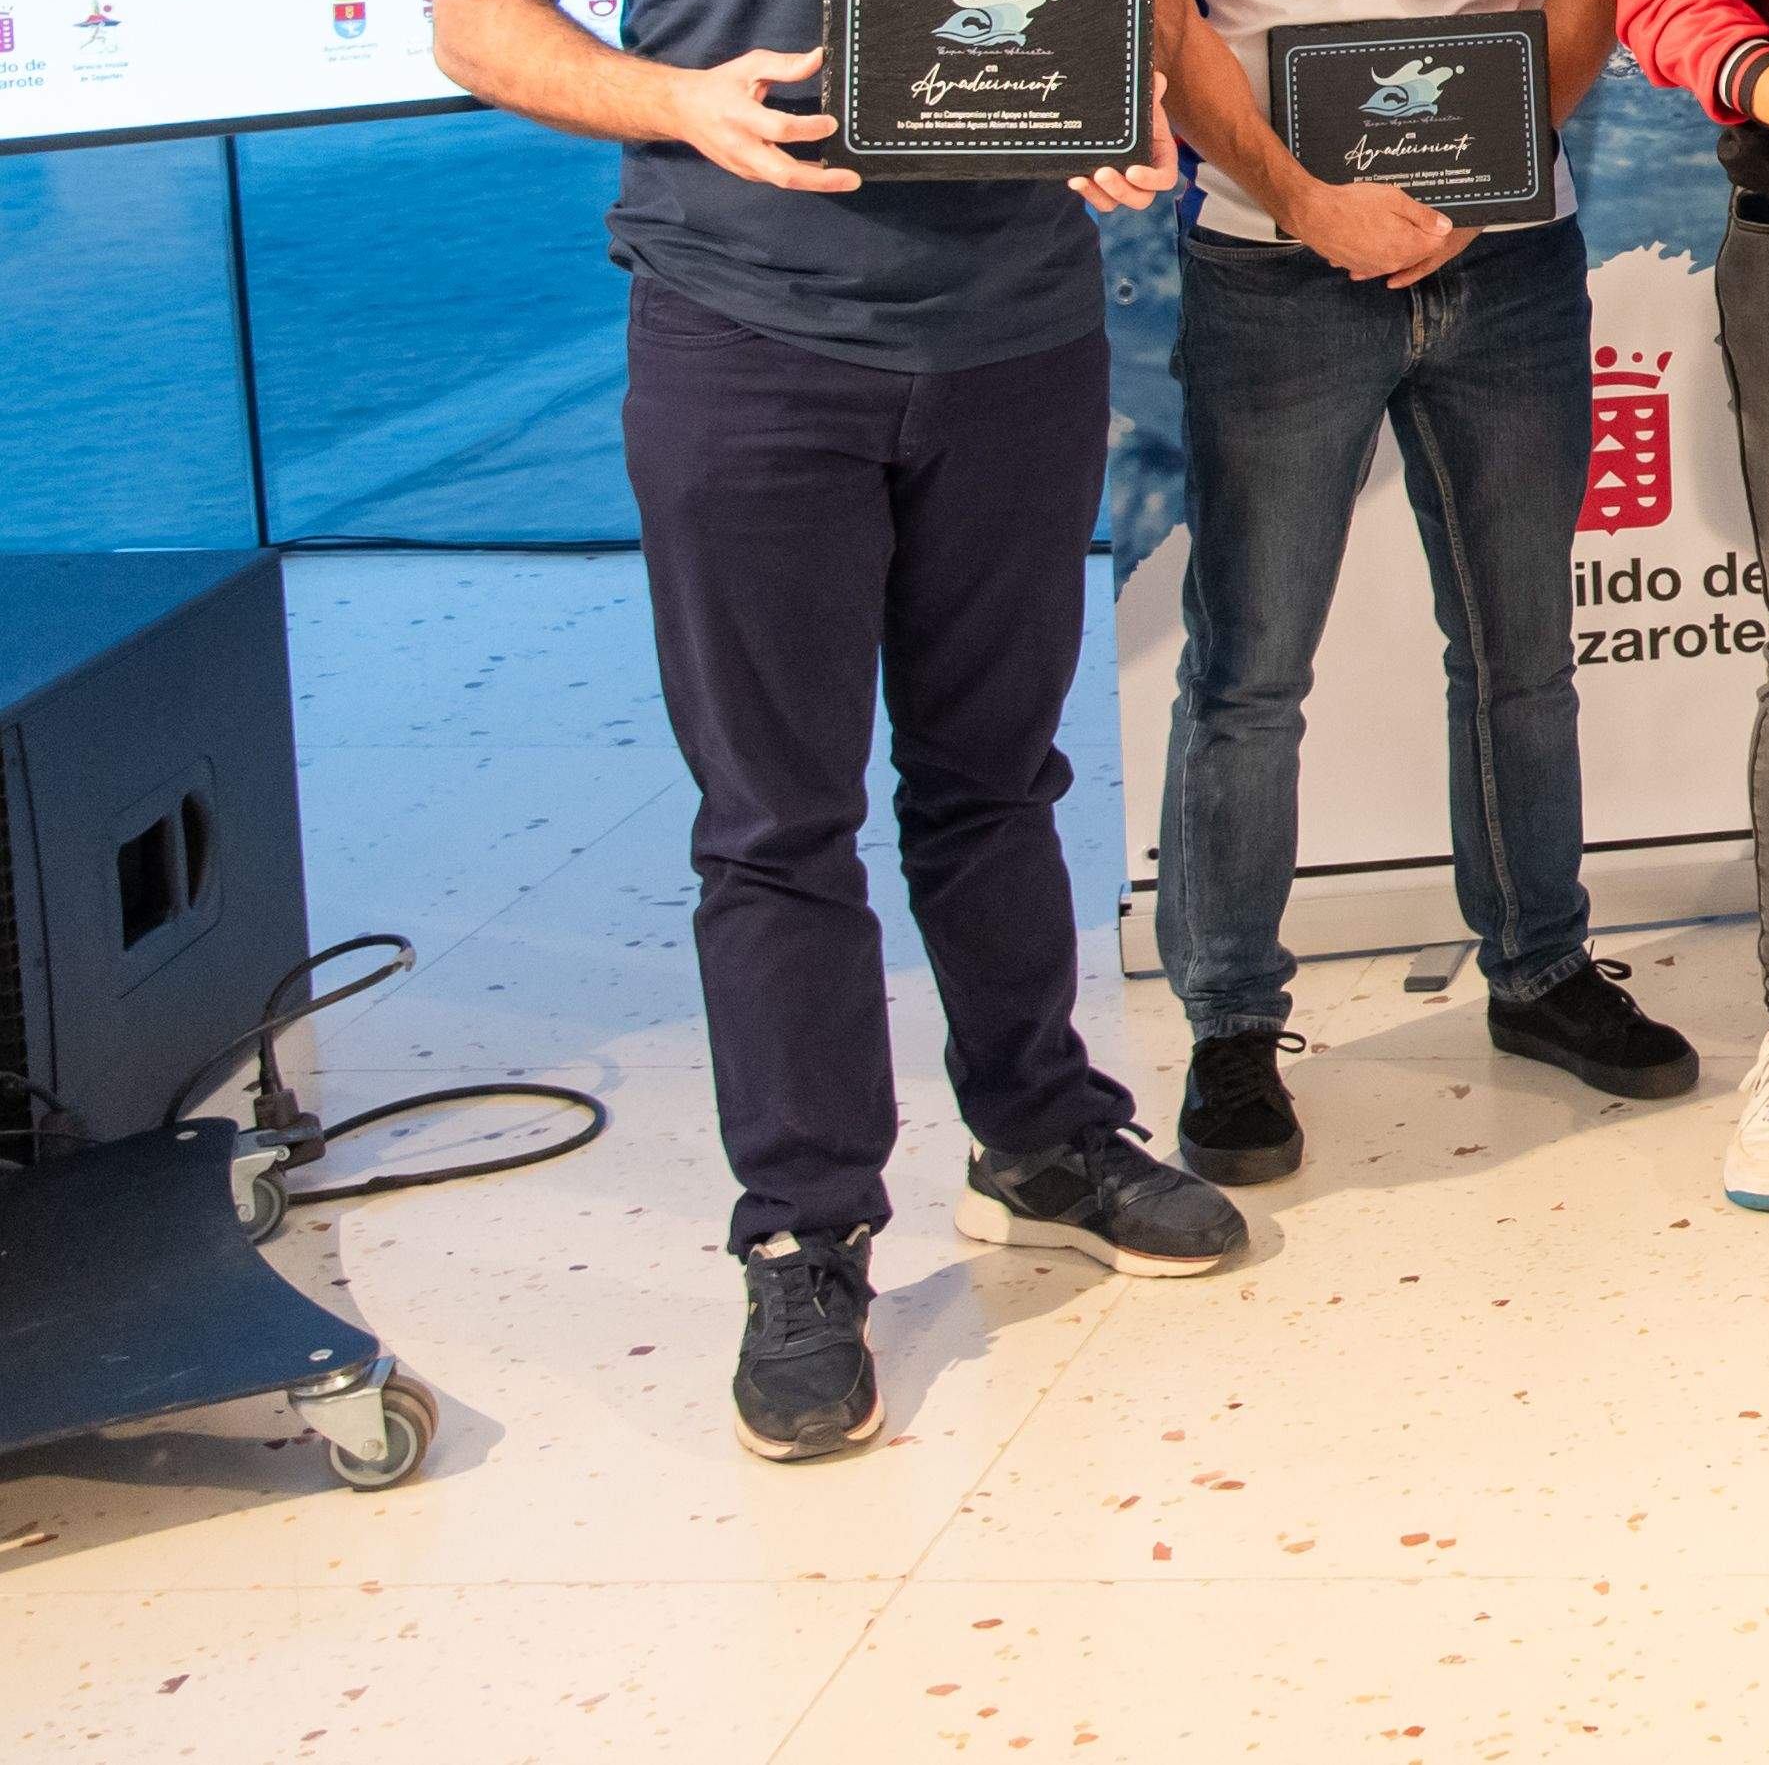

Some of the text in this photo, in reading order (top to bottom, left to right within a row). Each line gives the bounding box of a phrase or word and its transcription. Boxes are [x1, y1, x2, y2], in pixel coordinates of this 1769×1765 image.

[25, 59, 46, 72] de
[985, 64, 998, 73] en
[1575, 552, 1764, 606] ildo de
[1578, 613, 1766, 665] zarote
